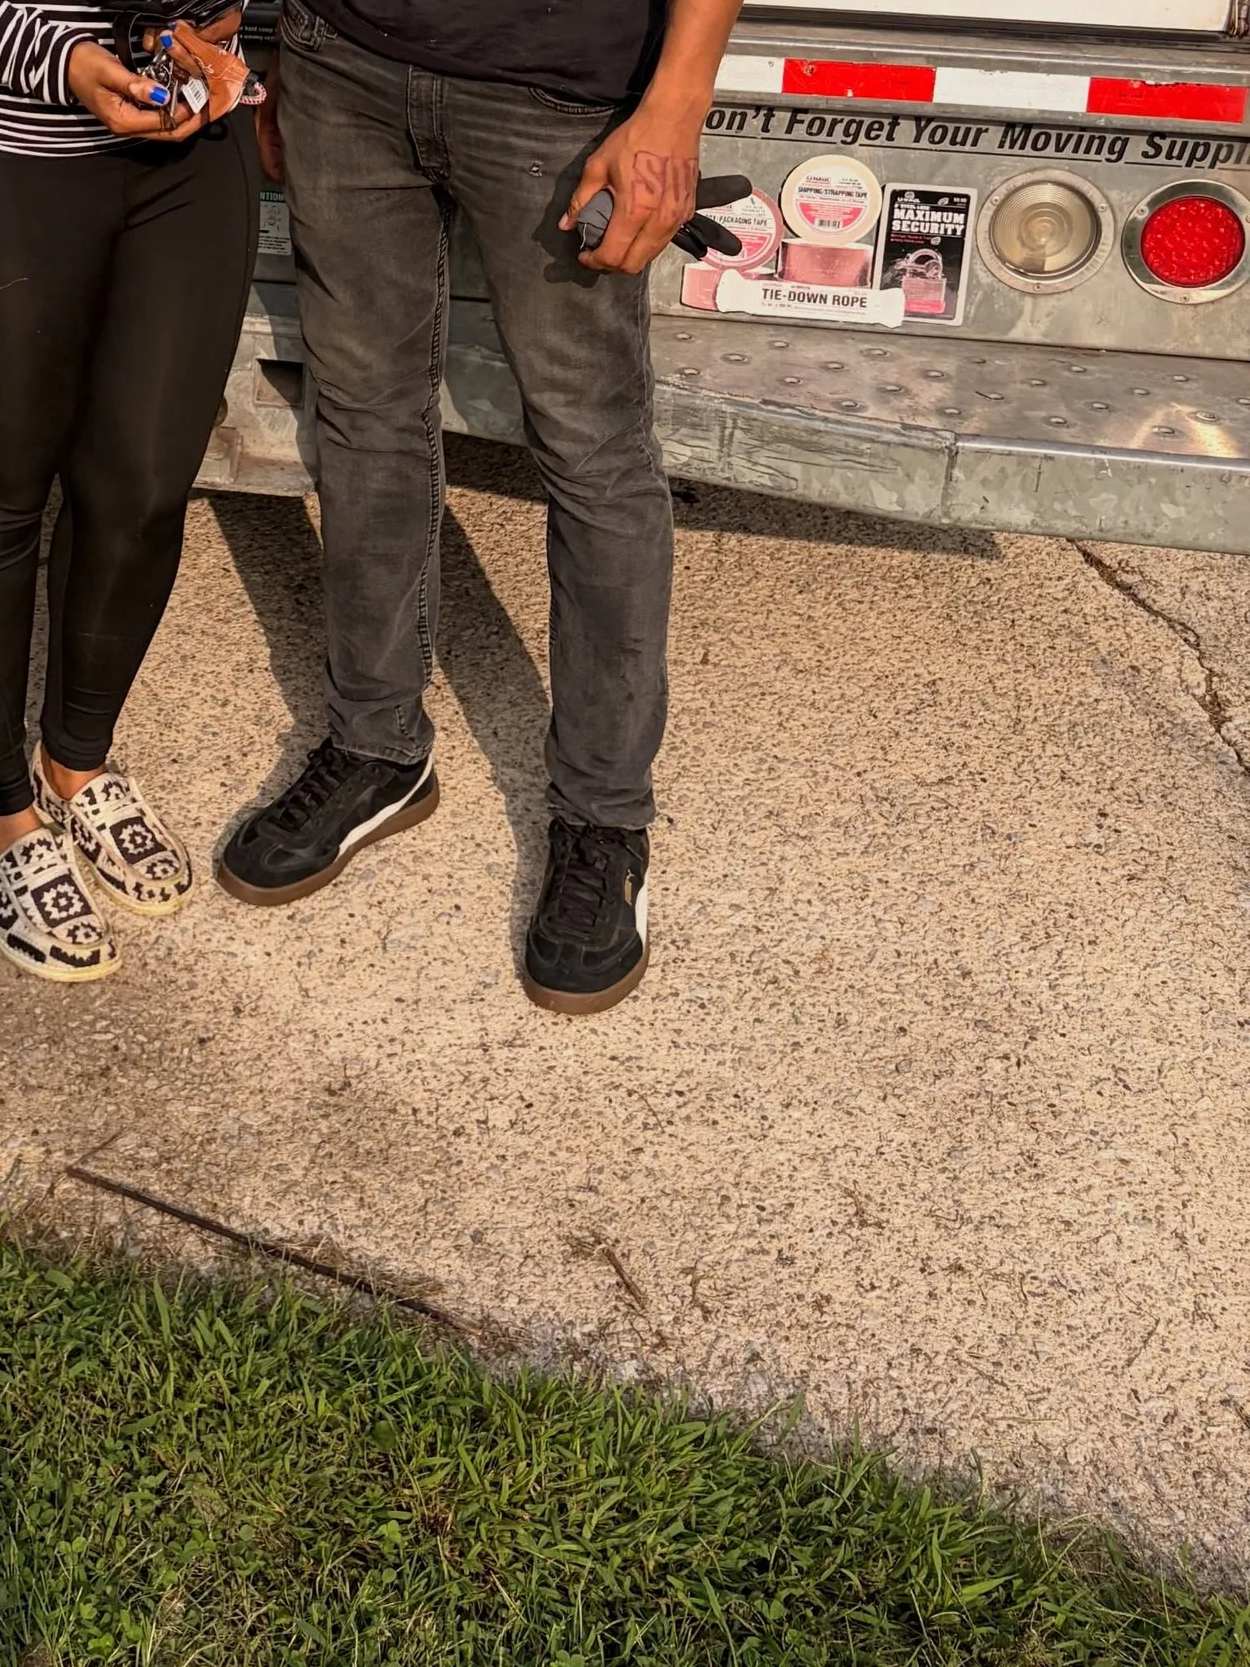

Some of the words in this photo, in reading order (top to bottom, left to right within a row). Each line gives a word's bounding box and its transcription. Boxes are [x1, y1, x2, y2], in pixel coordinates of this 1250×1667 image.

[705, 108, 776, 134] on't
[785, 108, 900, 145] Forget
[911, 115, 989, 148] Your
[997, 121, 1130, 163] Moving
[753, 219, 768, 227] TAPE
[893, 208, 965, 224] MAXIMUM
[891, 219, 965, 236] SECURITY
[762, 288, 828, 305] TIE-DOWN
[832, 294, 867, 308] ROPE
